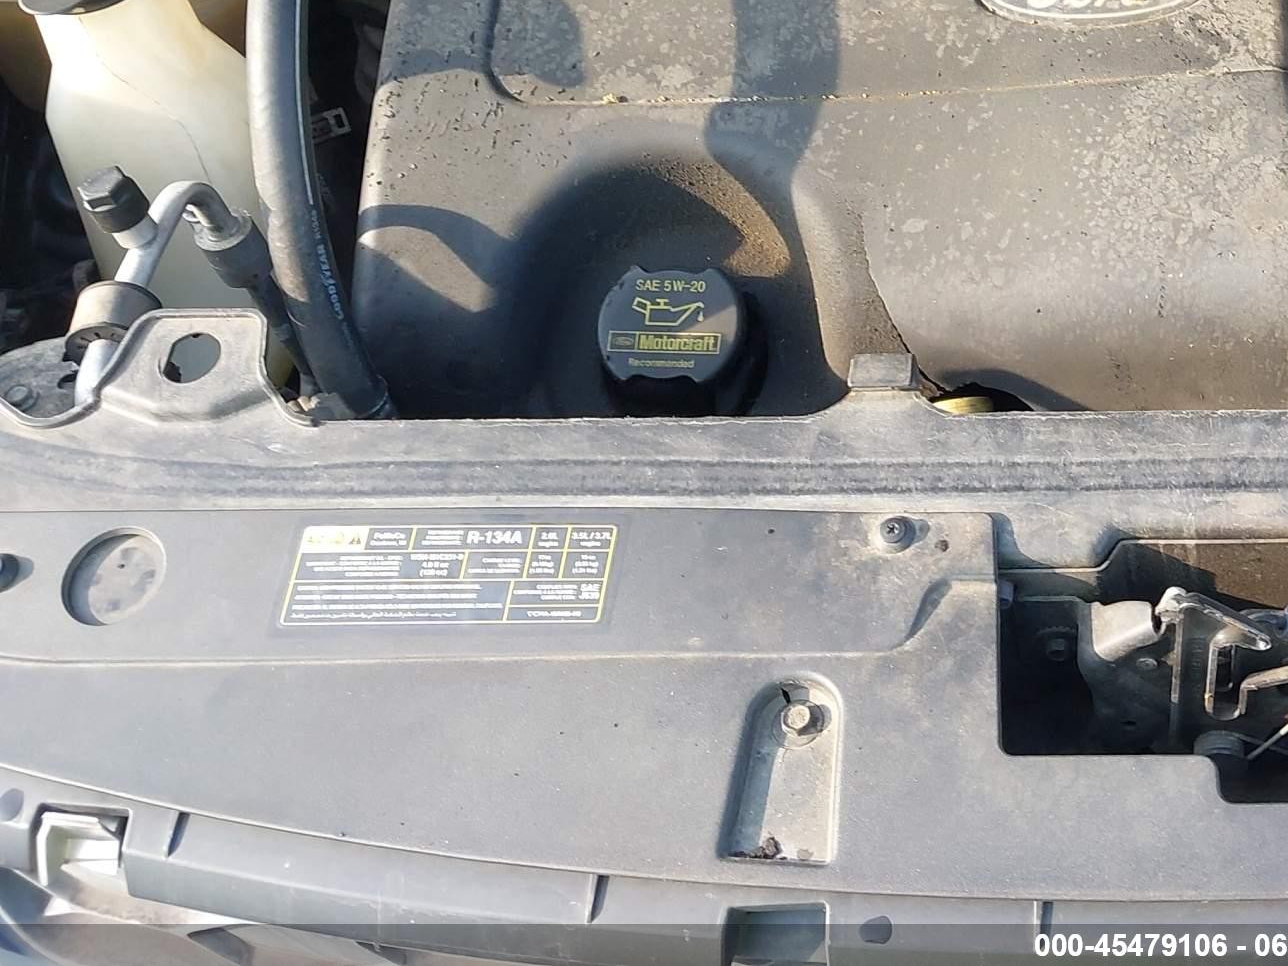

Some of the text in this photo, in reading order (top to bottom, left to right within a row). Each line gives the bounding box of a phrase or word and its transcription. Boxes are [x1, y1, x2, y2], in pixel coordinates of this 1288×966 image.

[635, 279, 706, 293] SAE 5W-20
[639, 334, 715, 352] Motorcraft
[466, 530, 522, 544] R-134A
